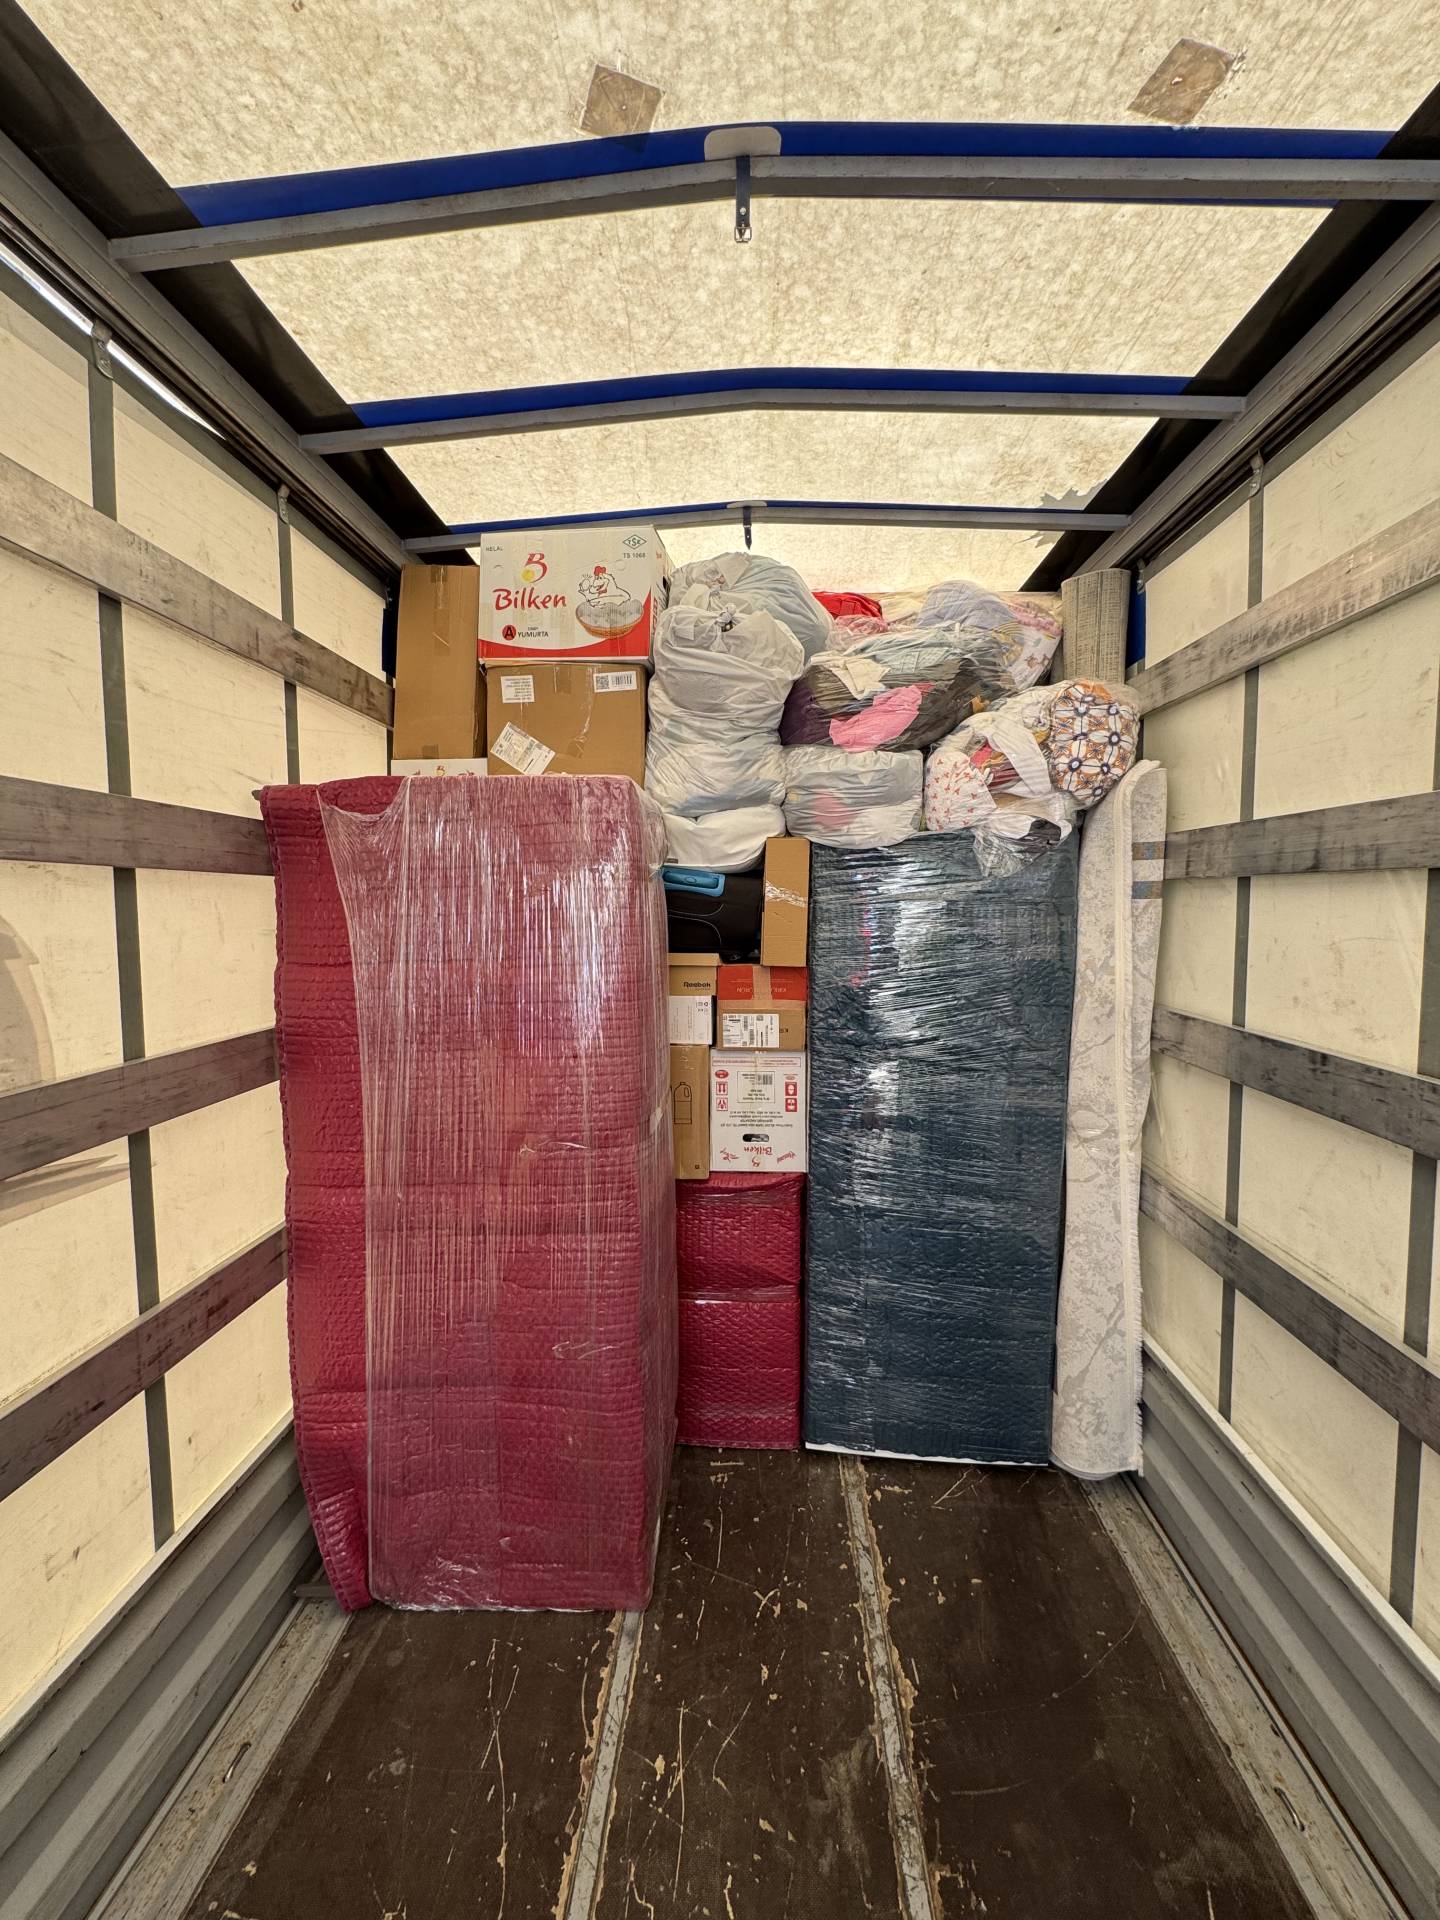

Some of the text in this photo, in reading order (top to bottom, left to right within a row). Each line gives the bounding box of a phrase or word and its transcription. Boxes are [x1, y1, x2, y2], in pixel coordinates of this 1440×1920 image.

[493, 586, 567, 611] Bilken
[518, 631, 549, 639] YUMURTA
[743, 1145, 774, 1156] Bilken
